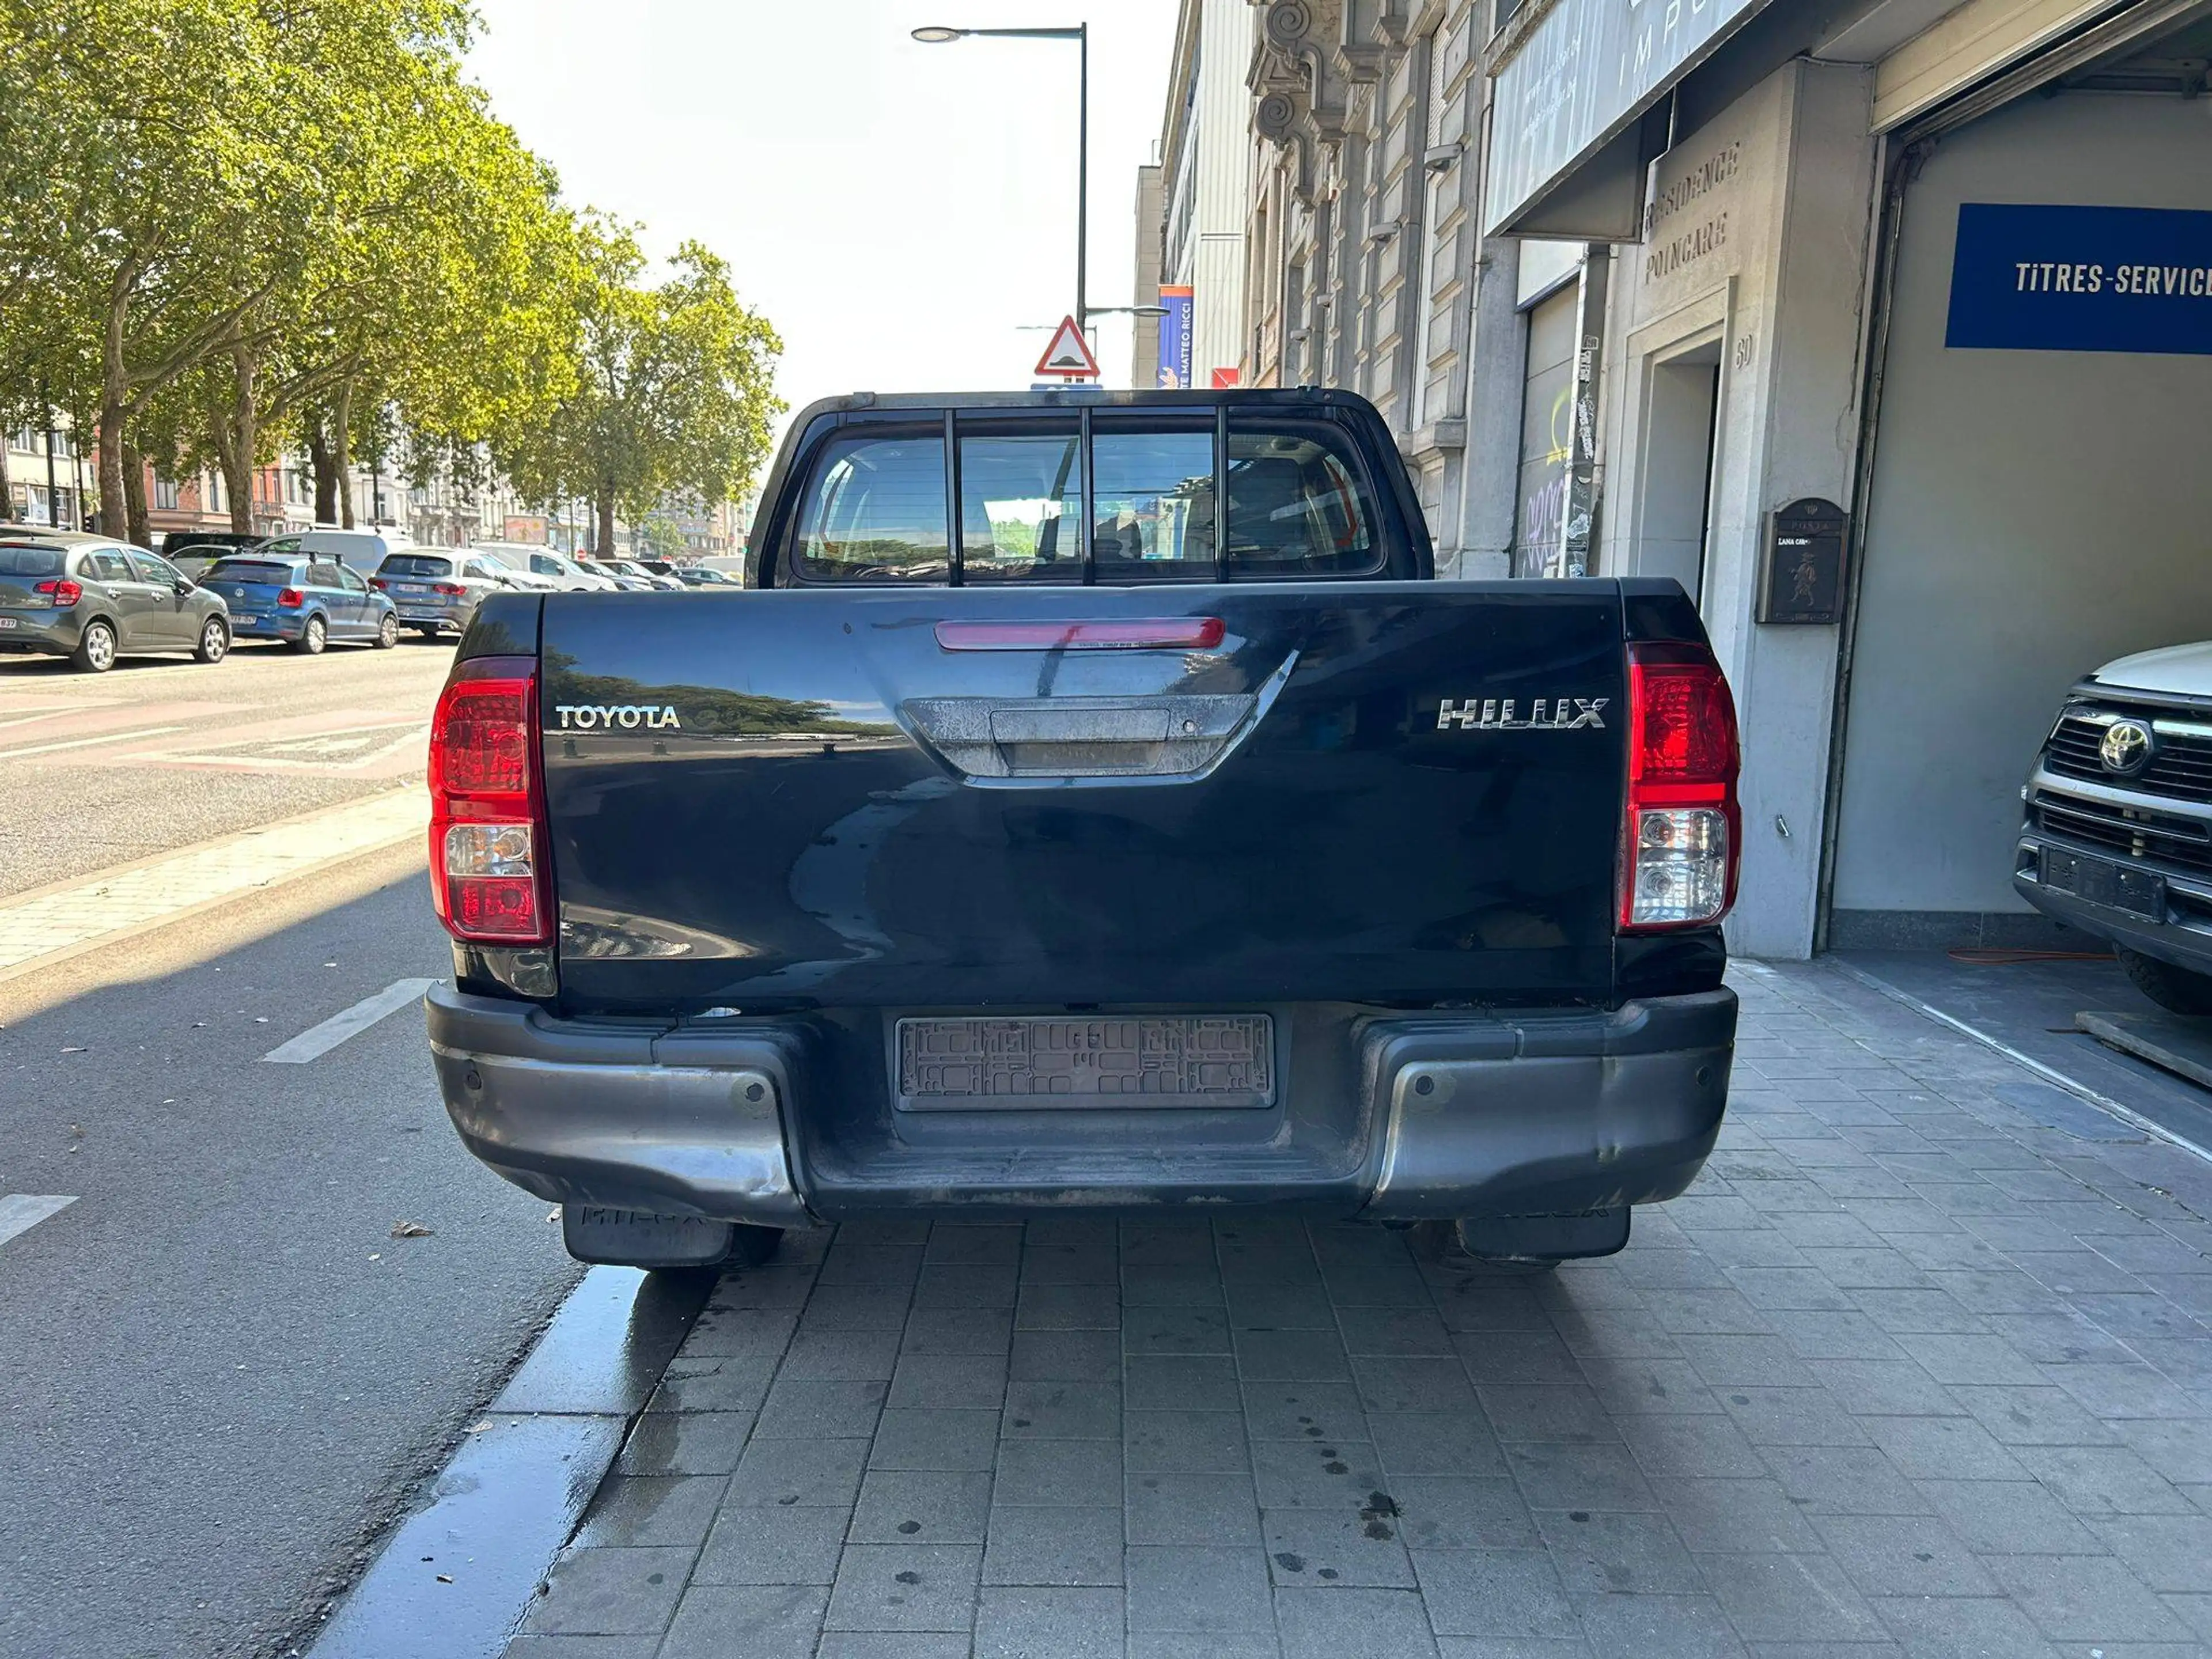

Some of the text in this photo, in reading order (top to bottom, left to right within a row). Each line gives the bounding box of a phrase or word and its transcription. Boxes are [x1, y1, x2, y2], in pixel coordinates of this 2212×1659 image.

[1181, 302, 1191, 329] RICCI
[1181, 332, 1191, 374] MATTEO
[555, 705, 681, 729] TOYOTA
[1437, 698, 1610, 729] HILUX
